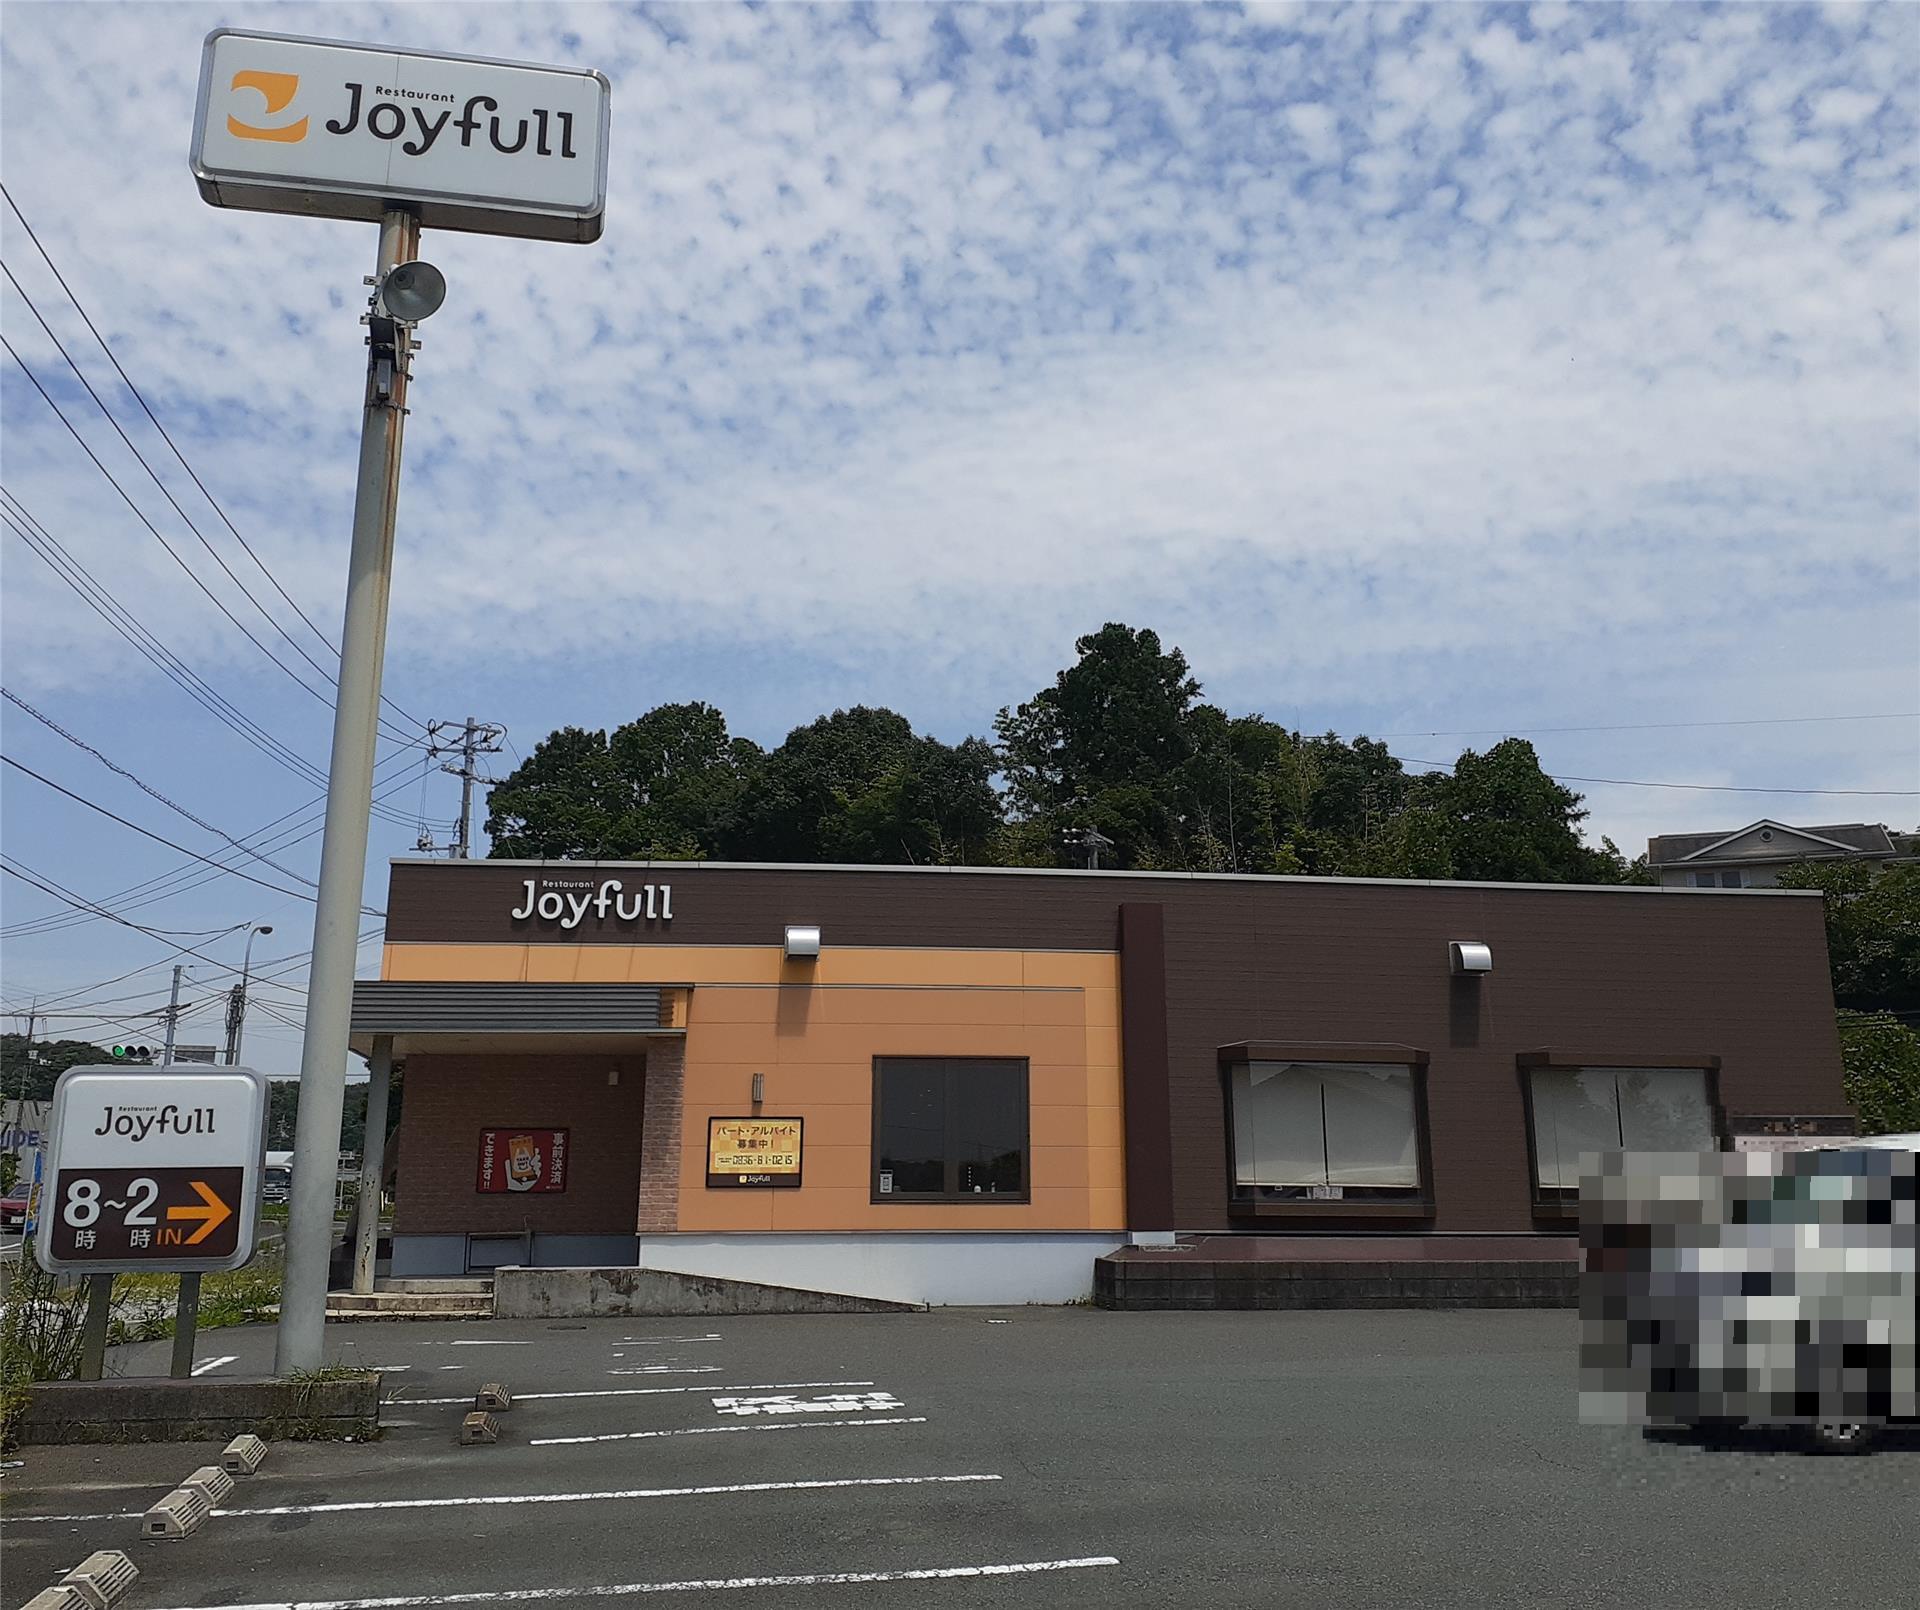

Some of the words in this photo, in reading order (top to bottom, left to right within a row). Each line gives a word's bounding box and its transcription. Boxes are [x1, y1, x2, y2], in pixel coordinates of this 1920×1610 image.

[375, 85, 456, 103] Restaurant
[325, 82, 577, 159] Joyfull
[542, 879, 595, 889] Restaurant
[511, 879, 673, 929] Joyfull
[94, 1104, 216, 1142] Joyfull
[717, 1126, 797, 1136] パート・アルバイト
[550, 1132, 565, 1184] 事前決済
[74, 1229, 97, 1250] 時
[129, 1228, 151, 1249] 時
[156, 1228, 182, 1245] IN
